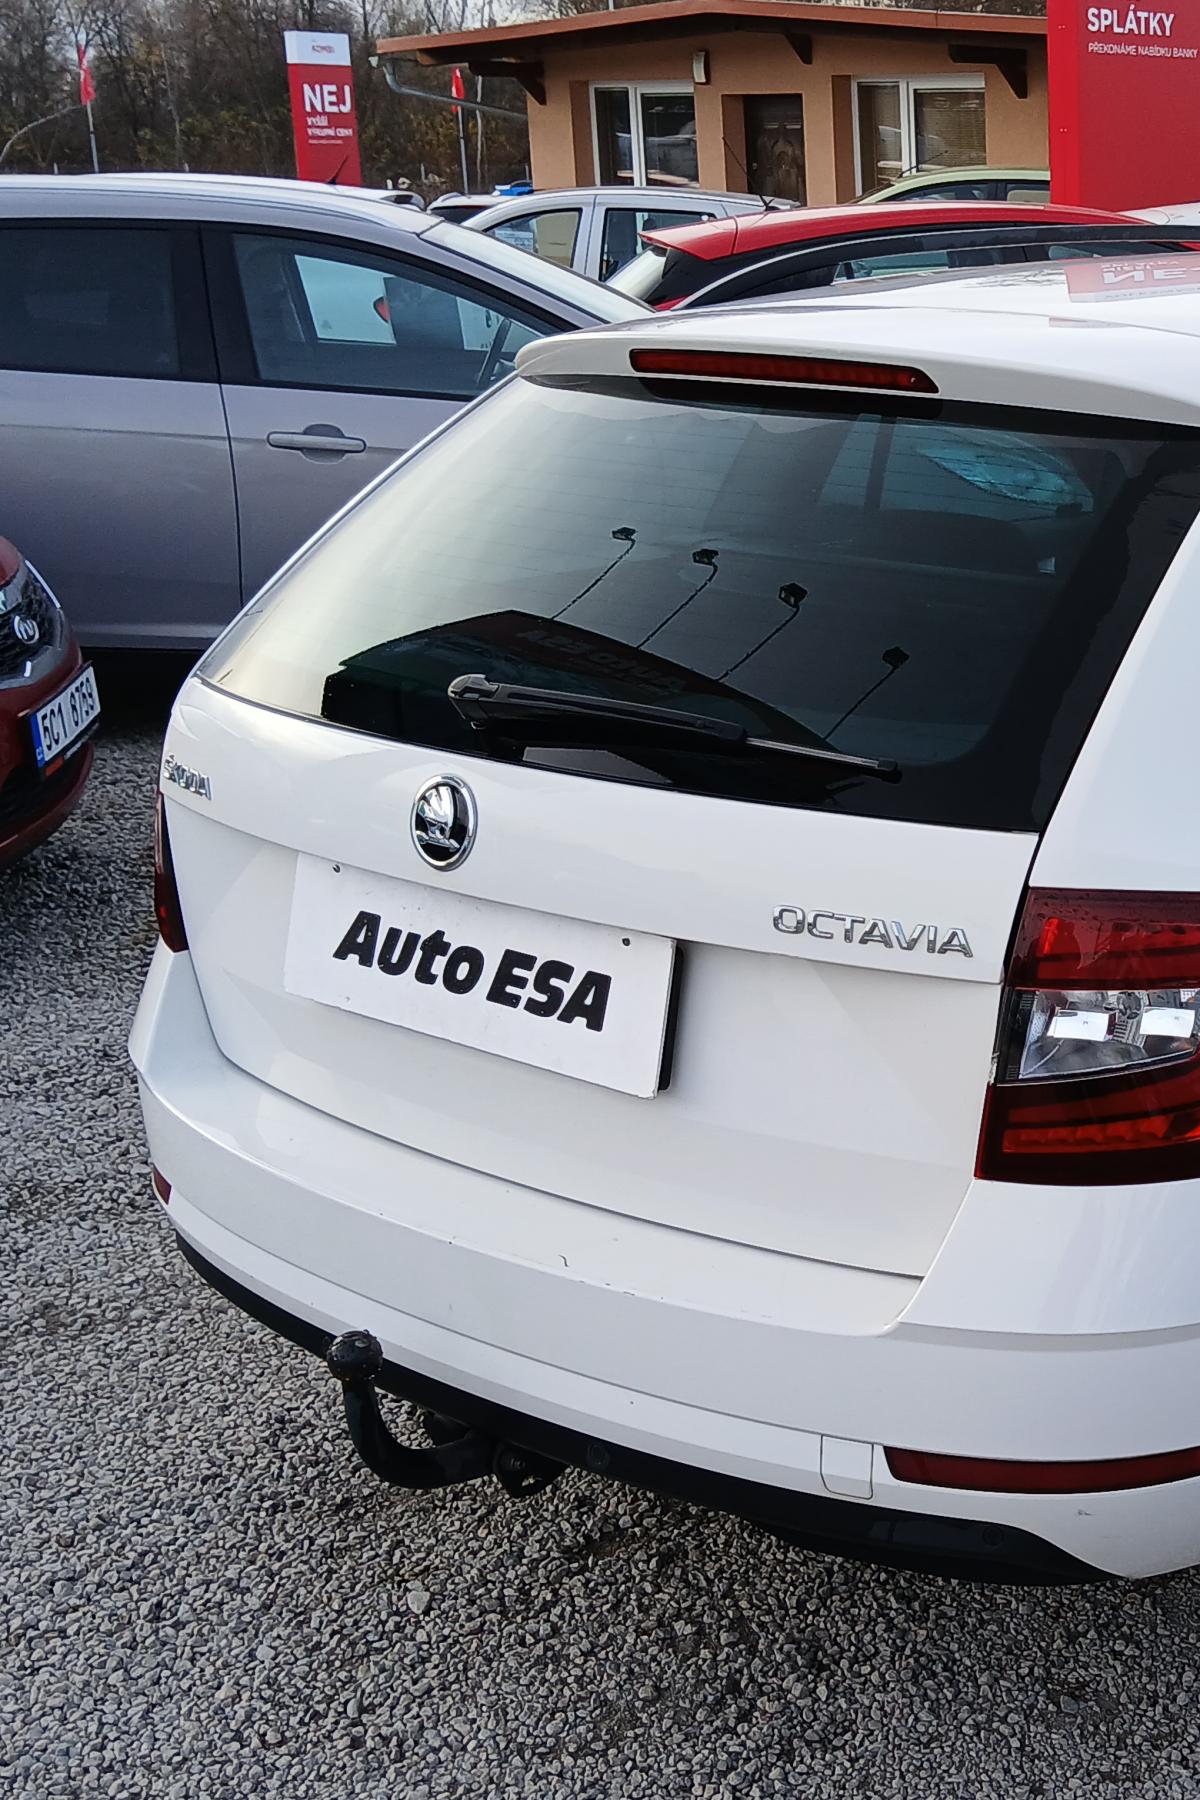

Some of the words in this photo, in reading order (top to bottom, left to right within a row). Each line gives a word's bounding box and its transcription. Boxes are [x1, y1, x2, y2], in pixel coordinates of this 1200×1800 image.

[1087, 4, 1174, 36] SPLÁTKY
[1088, 42, 1137, 56] PŘEKONÁME
[1138, 45, 1172, 57] NABÍDKU
[1173, 47, 1199, 59] BANKY
[303, 83, 352, 113] NEJ
[41, 702, 68, 751] 5C1
[773, 904, 974, 958] OCTAVIA
[332, 910, 485, 995] Auto
[486, 948, 613, 1033] ESA
